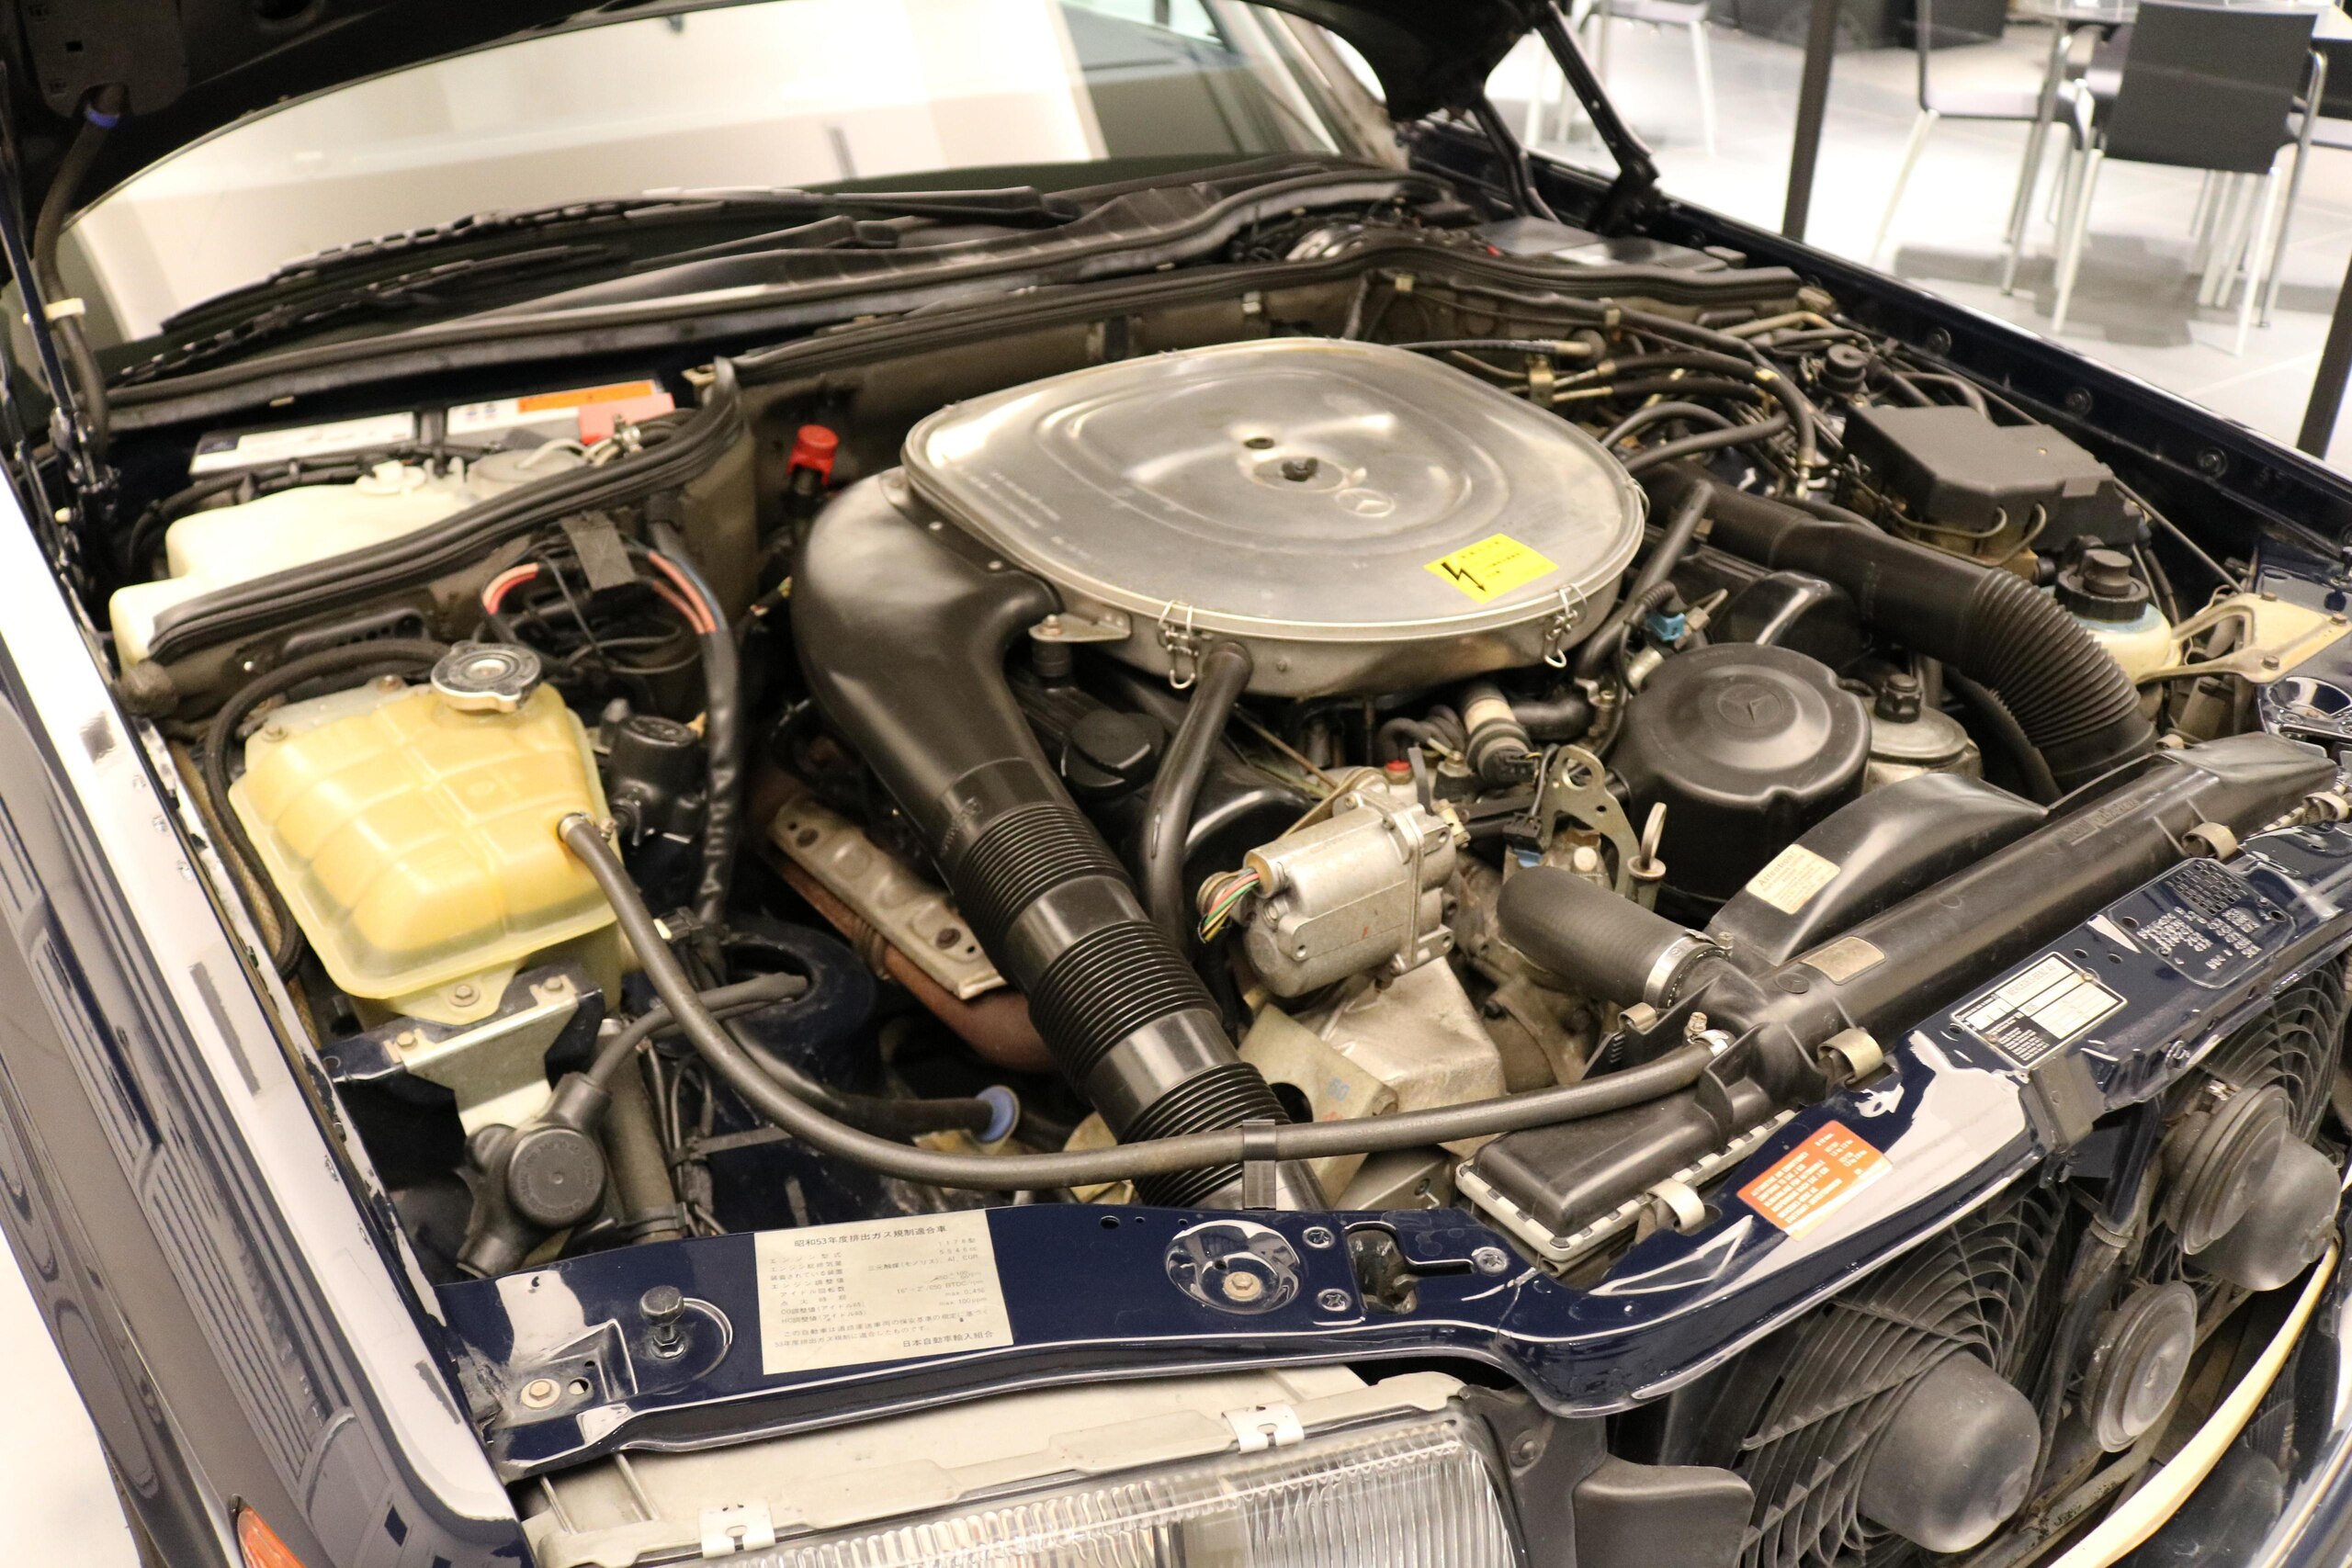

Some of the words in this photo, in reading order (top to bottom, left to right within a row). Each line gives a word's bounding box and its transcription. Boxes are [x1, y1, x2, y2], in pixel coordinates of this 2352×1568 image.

[793, 1224, 947, 1247] 昭和53年度排出ガス規制適合車
[901, 1329, 994, 1348] 日本自動車輸入組合
